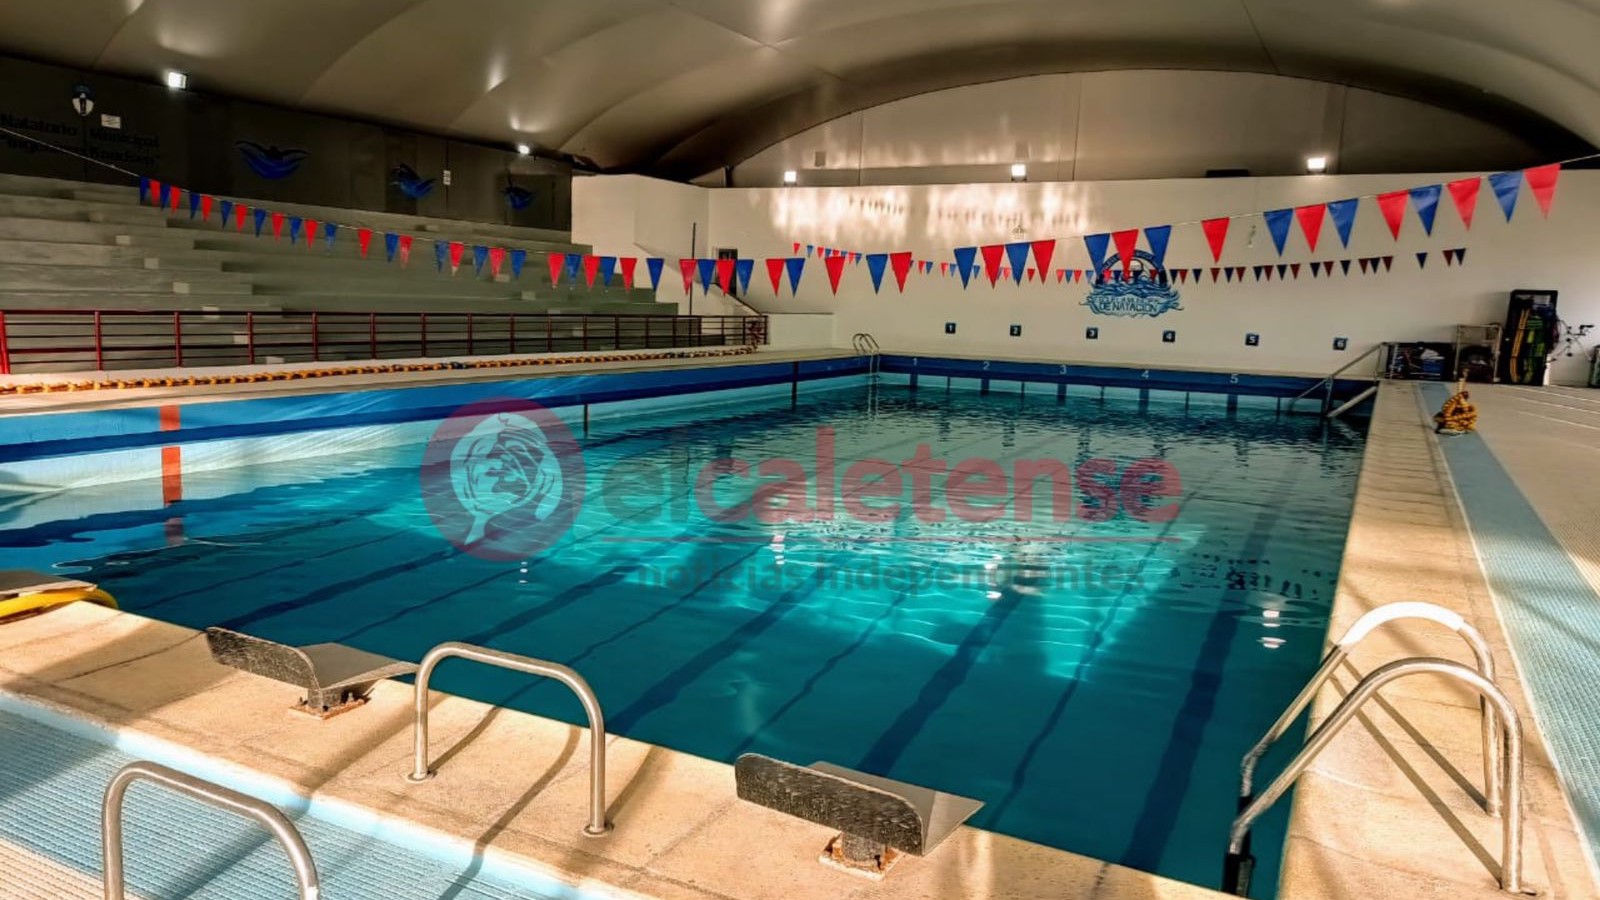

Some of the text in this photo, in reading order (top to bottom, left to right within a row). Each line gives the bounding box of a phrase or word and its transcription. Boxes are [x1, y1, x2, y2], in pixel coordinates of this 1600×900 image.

[982, 361, 991, 371] 2
[1059, 364, 1068, 375] 3
[1140, 369, 1150, 380] 4
[1229, 373, 1239, 384] 5
